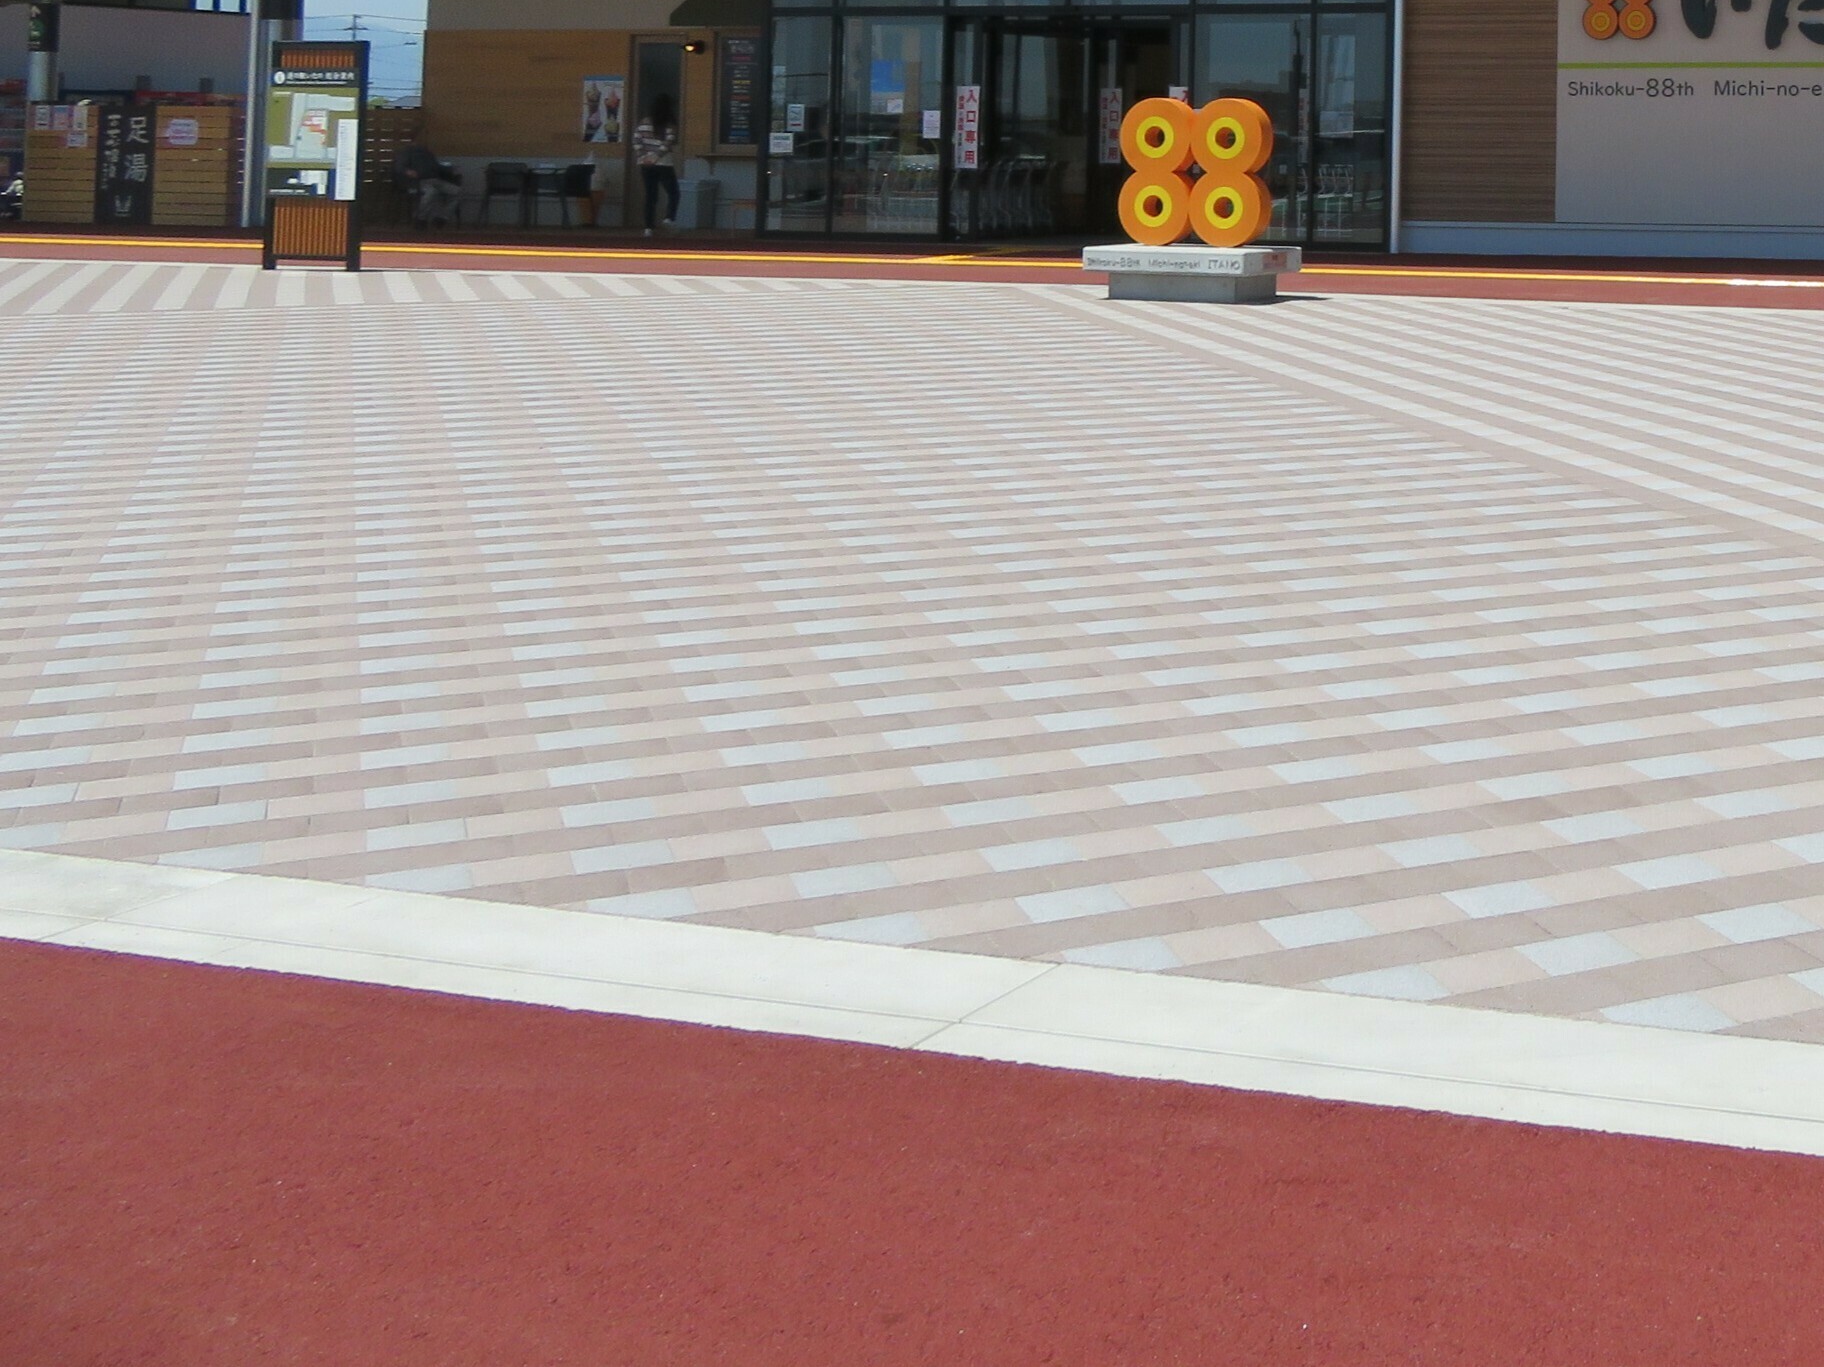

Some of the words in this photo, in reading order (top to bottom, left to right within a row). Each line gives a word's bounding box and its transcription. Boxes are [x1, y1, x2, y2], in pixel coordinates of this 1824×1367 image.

[1567, 78, 1694, 98] Shikoku-88th
[124, 116, 150, 183] 足湯
[964, 89, 978, 165] 入口専用
